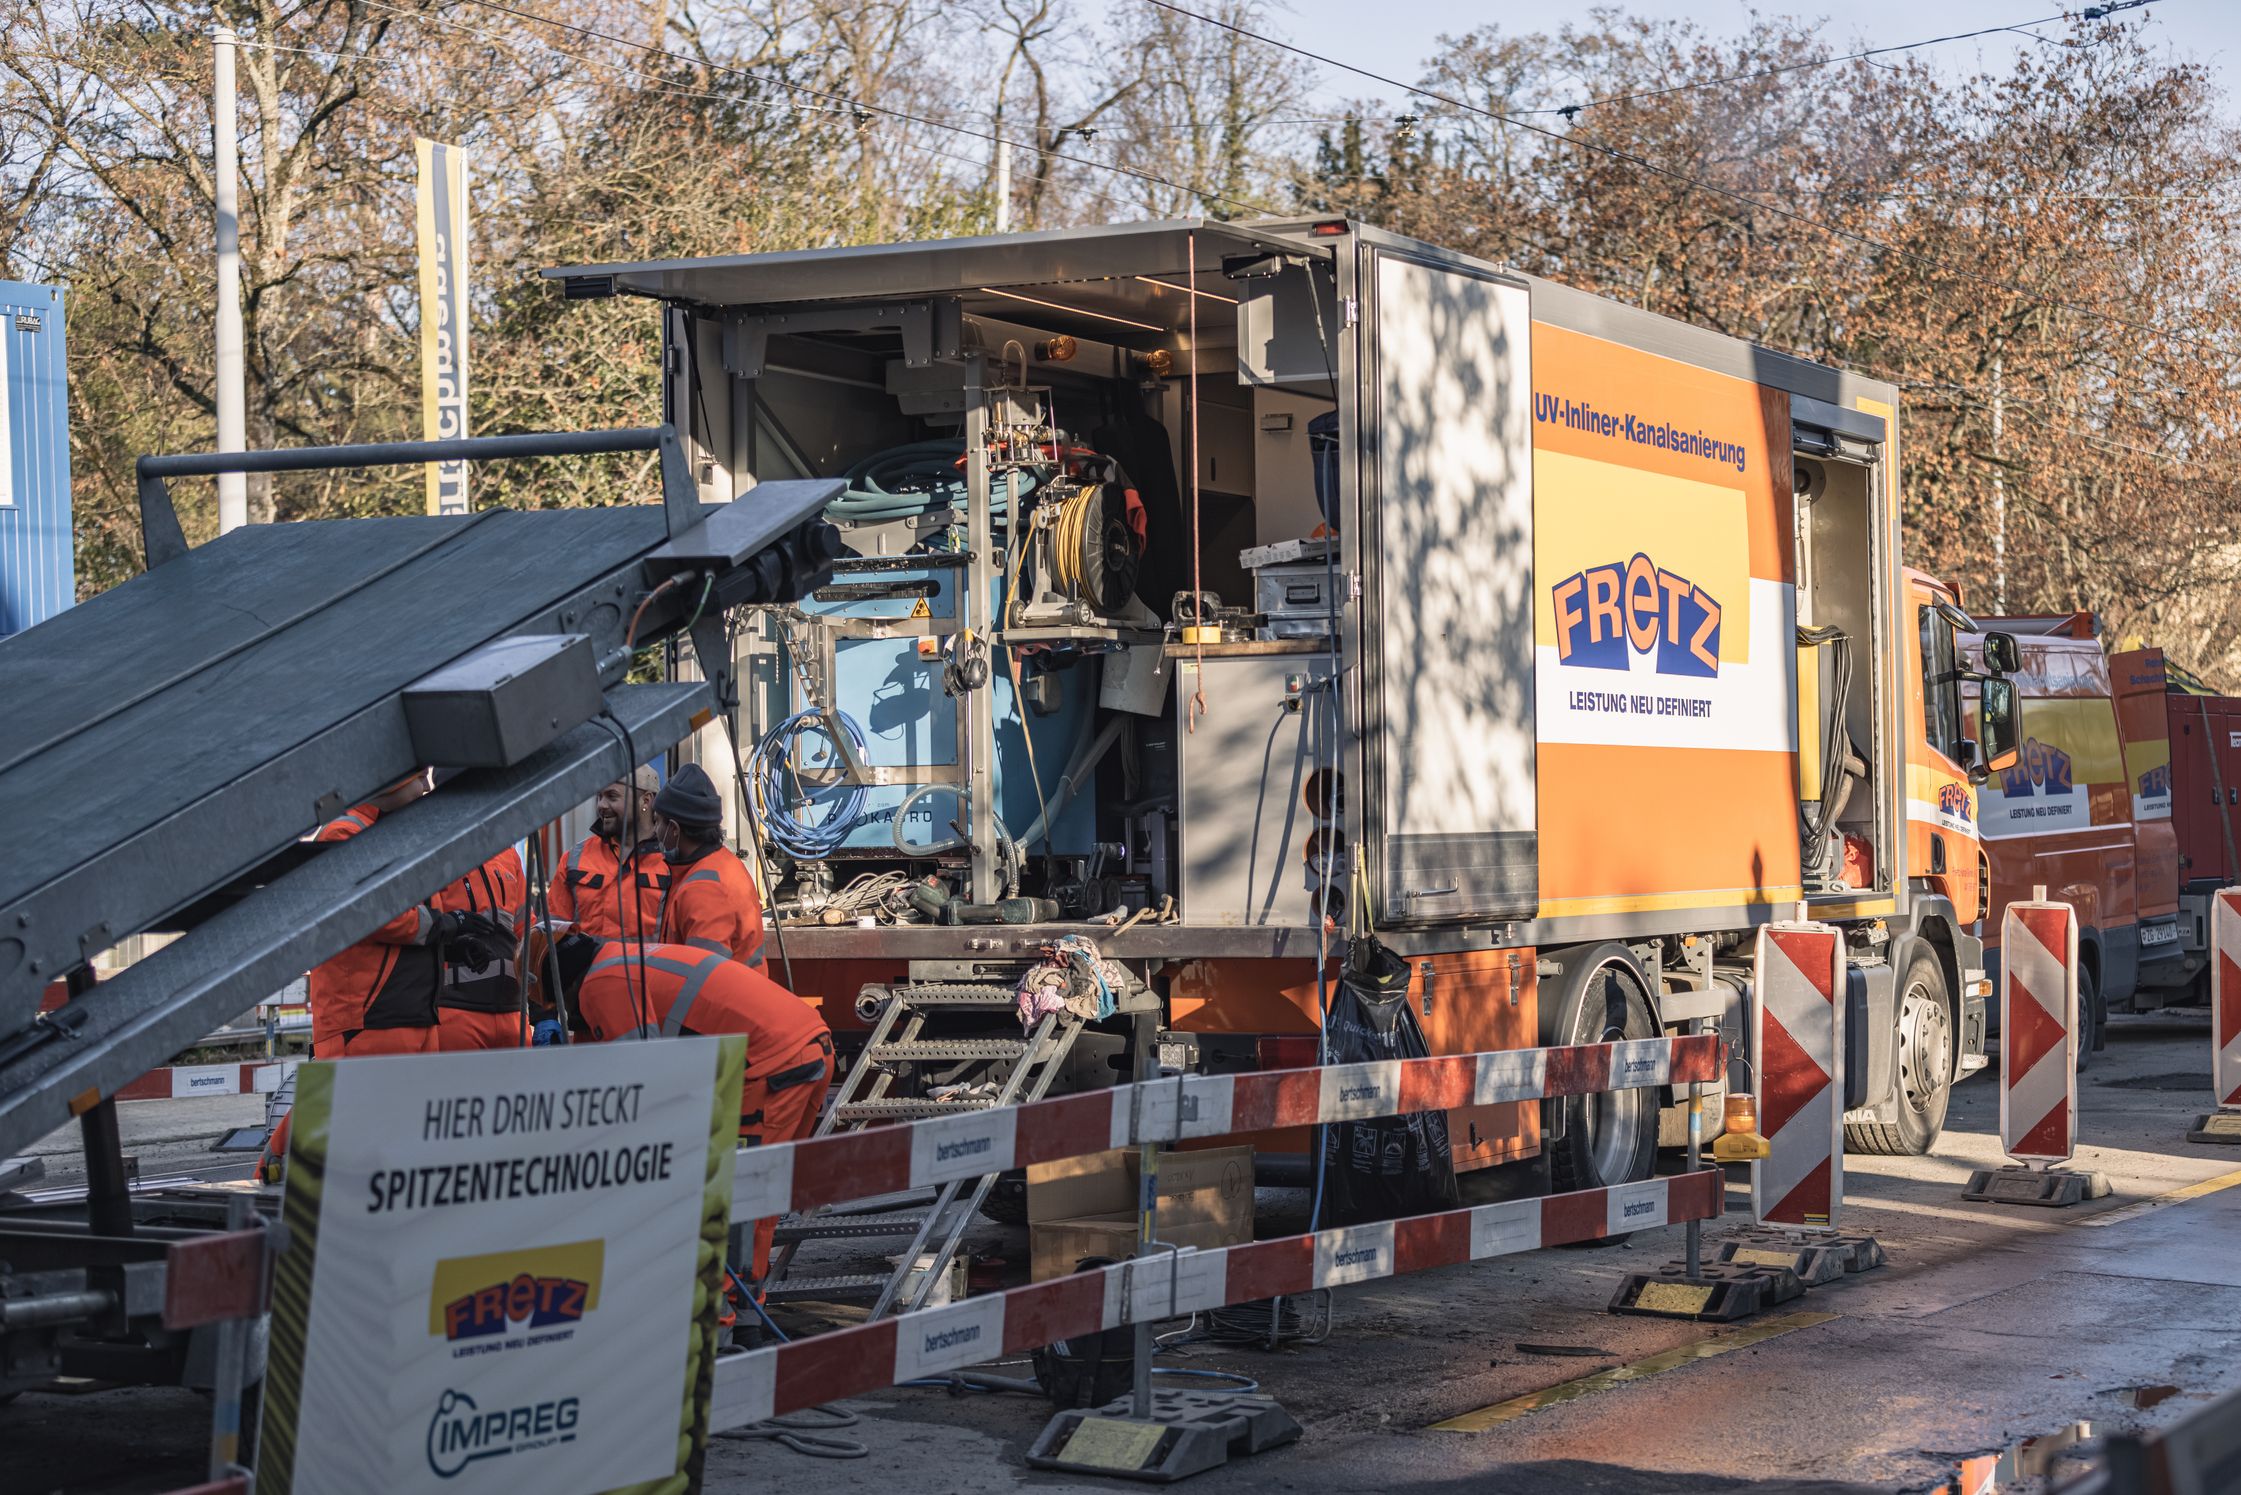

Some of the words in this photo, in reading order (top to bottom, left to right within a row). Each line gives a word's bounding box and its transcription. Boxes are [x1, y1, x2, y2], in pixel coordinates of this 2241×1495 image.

[1534, 391, 1745, 473] UV-Inliner-Kanalsanierung
[1569, 690, 1627, 713] LEISTUNG
[1630, 694, 1653, 716] NEU
[1656, 696, 1712, 718] DEFINIERT
[2010, 807, 2035, 819] LEISTUNG
[2036, 806, 2047, 817] NEU
[2047, 805, 2072, 816] DEFINIERT
[1625, 1057, 1656, 1073] bertschmann
[190, 1076, 225, 1088] bertschmann
[1339, 1084, 1381, 1103] bertschmann
[423, 1097, 486, 1141] HIER
[492, 1091, 556, 1136] DRIN
[560, 1083, 644, 1130] STECKT
[937, 1136, 991, 1162] bertschmann
[366, 1142, 674, 1214] SPITZENTECHNOLOGIE
[1623, 1200, 1655, 1218] bertschmann
[1335, 1248, 1377, 1268] bertschmann
[453, 1340, 502, 1359] LEISTUNG
[504, 1337, 526, 1350] NEU
[527, 1330, 574, 1347] DEFINIERT
[925, 1325, 981, 1353] bertschmann
[440, 1397, 580, 1454] IMPREG
